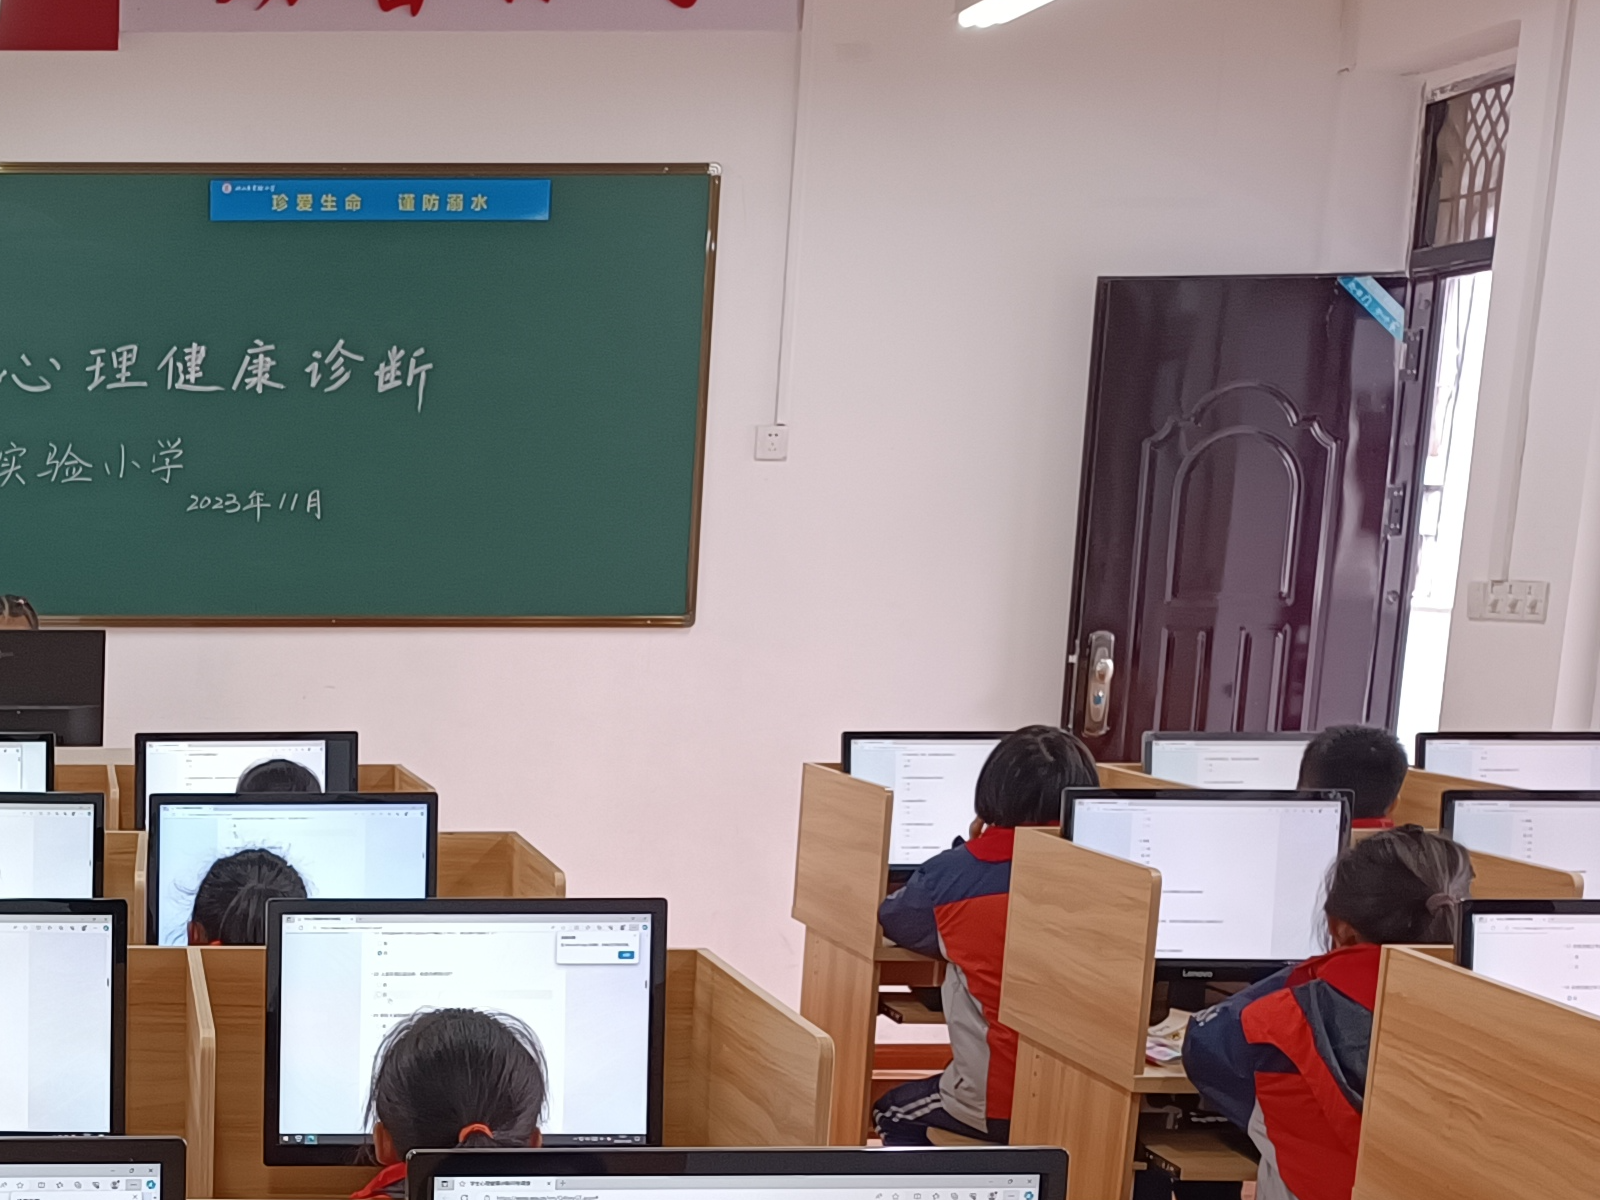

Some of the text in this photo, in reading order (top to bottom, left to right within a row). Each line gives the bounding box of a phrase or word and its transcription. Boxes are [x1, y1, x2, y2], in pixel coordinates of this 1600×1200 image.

[271, 193, 488, 212] 珍爱生命 谨防溺水
[186, 489, 325, 522] 2023年11月
